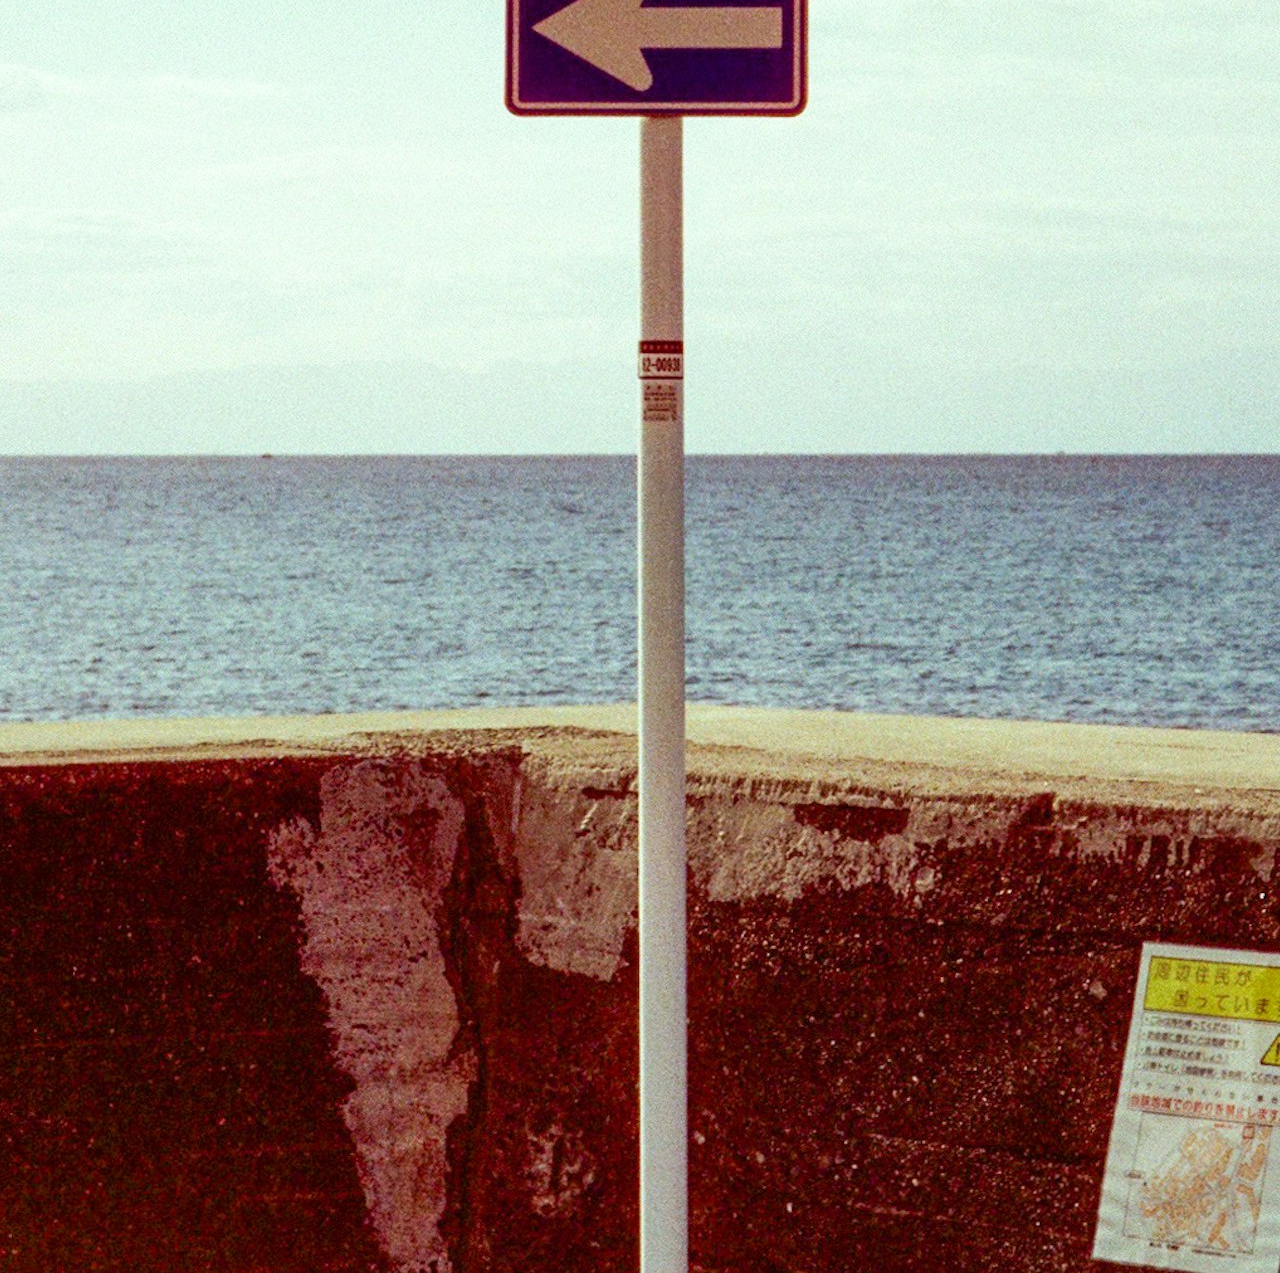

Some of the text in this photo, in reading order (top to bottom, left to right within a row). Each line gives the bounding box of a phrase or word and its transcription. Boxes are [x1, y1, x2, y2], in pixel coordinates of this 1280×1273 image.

[1153, 961, 1252, 987] 周辺住民が
